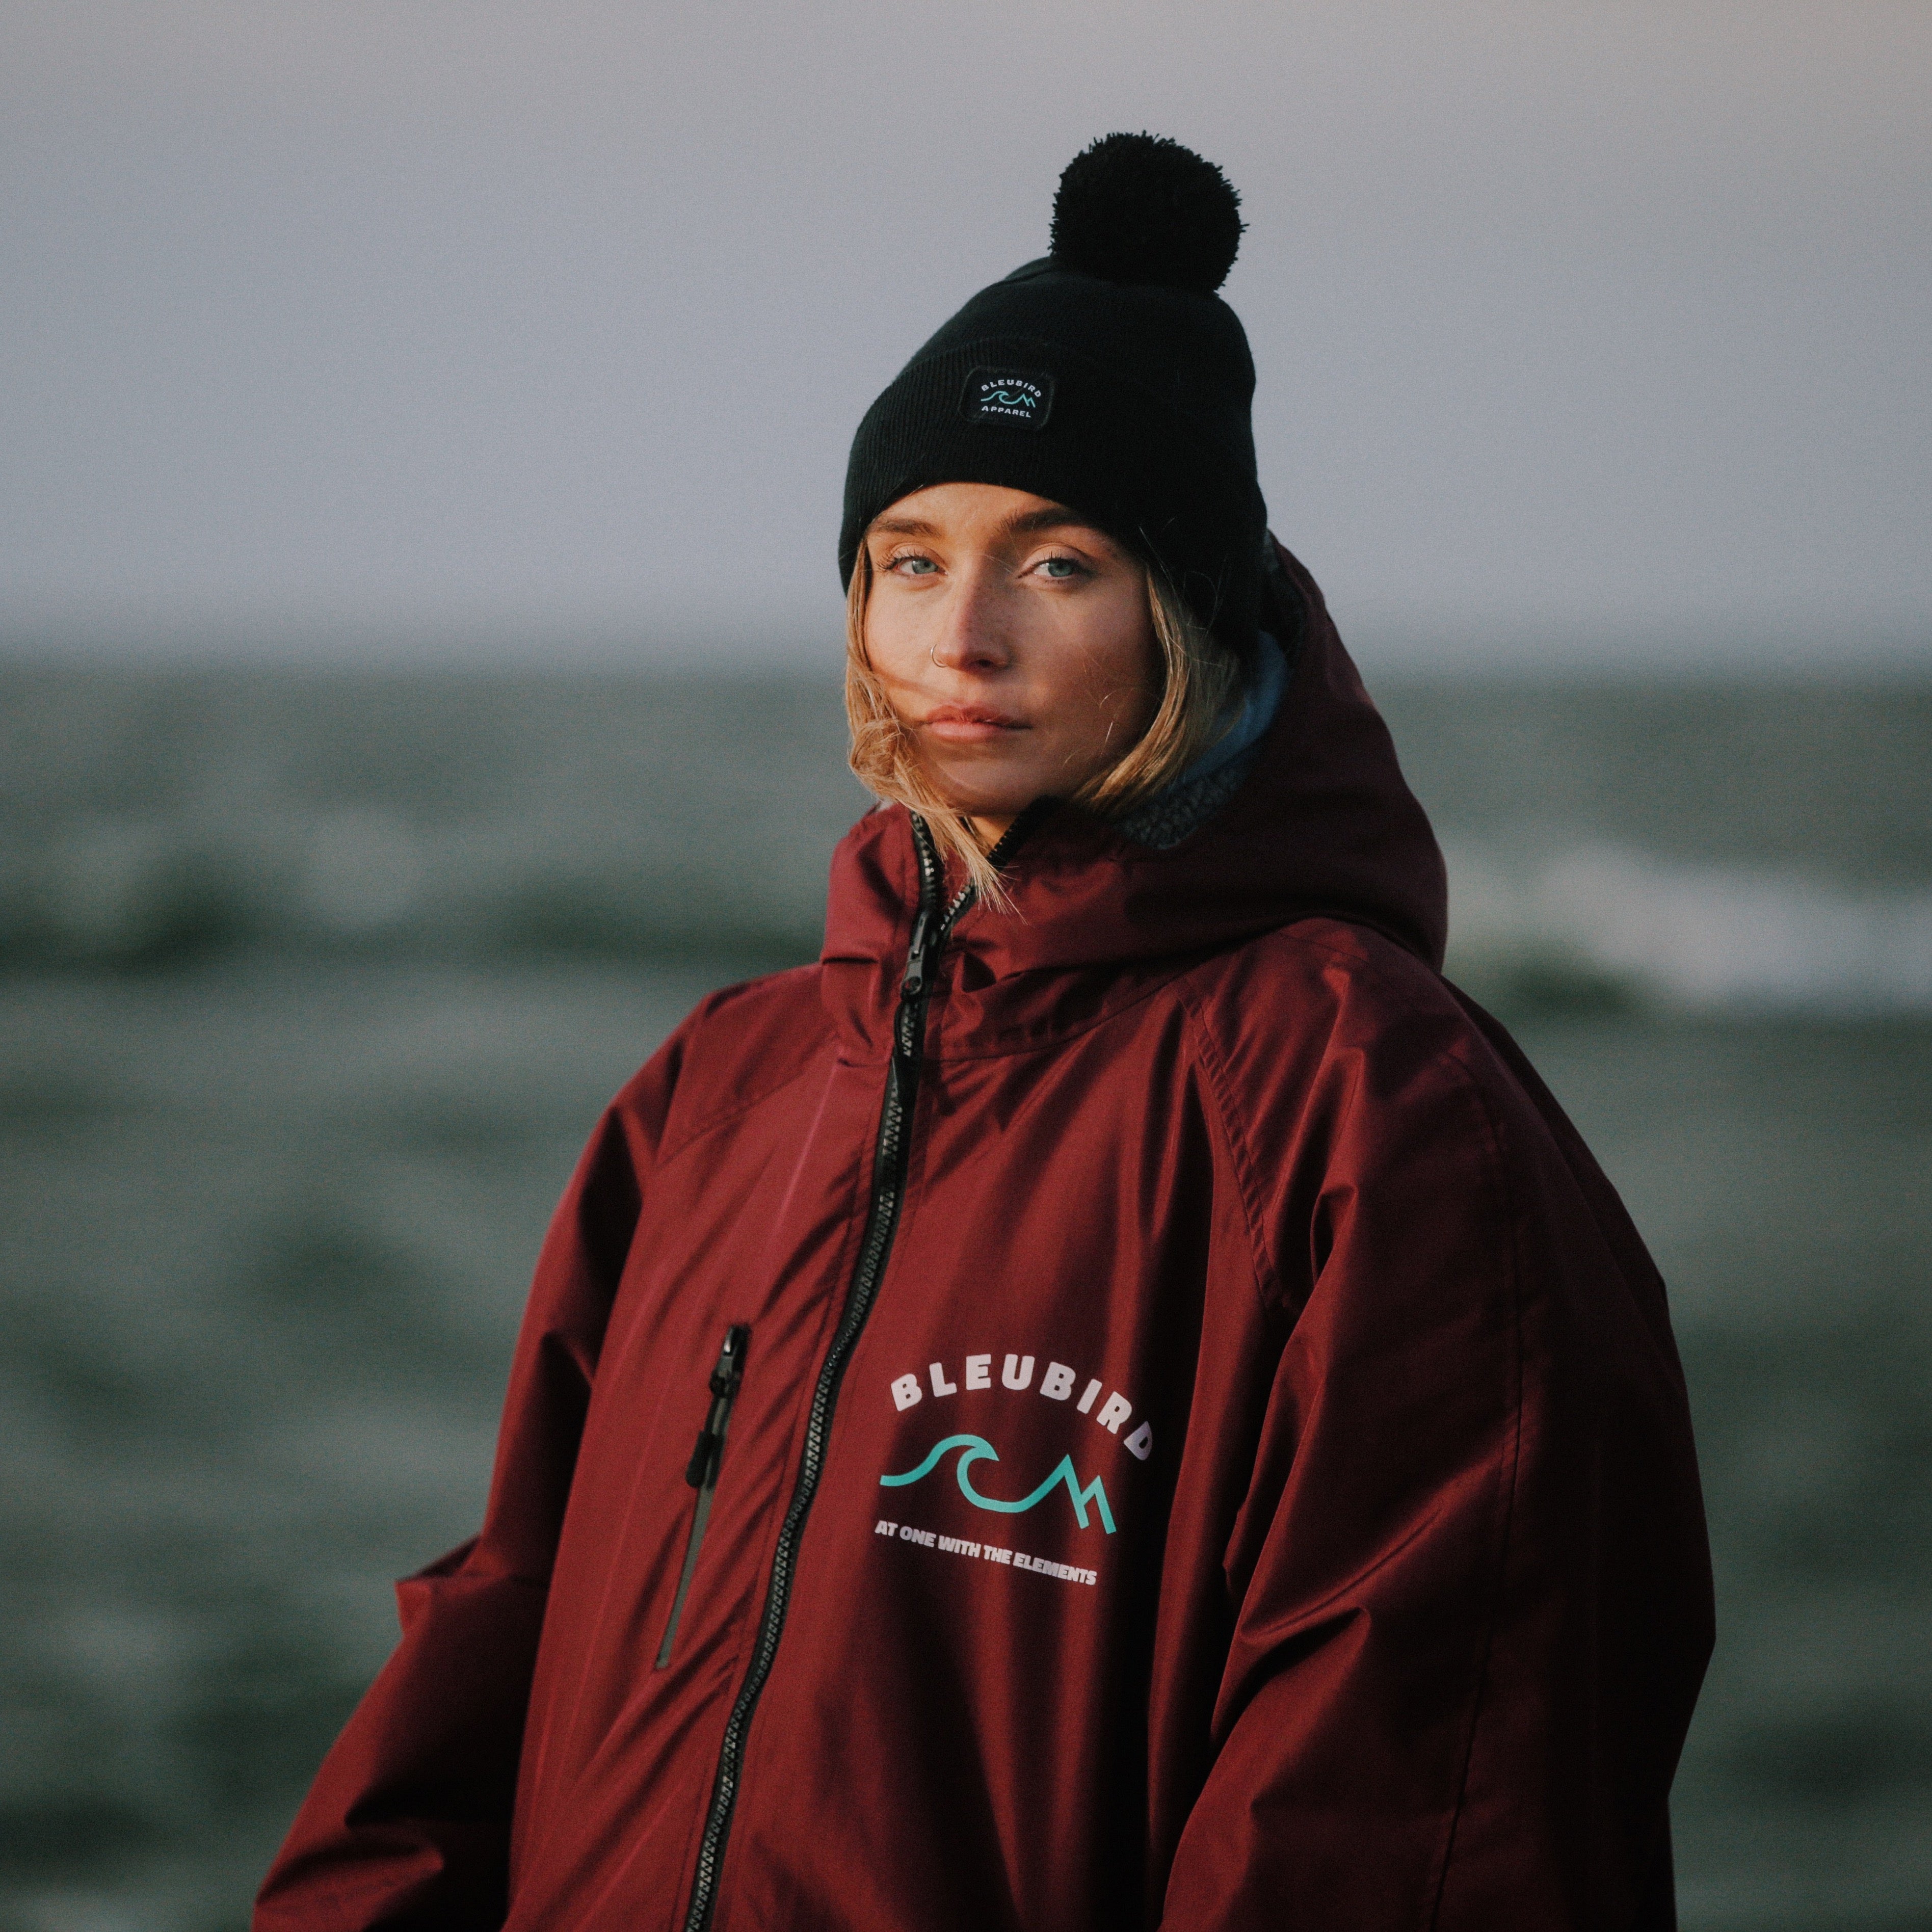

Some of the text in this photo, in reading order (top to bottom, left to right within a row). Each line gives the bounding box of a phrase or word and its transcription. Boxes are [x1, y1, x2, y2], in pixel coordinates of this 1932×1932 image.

[981, 379, 1041, 398] BLEUBIRD
[982, 406, 1031, 418] APPAREL
[890, 1354, 1153, 1461] BLEUBIRD
[875, 1520, 1097, 1585] AT ONE WITH THE ELEMENTS
